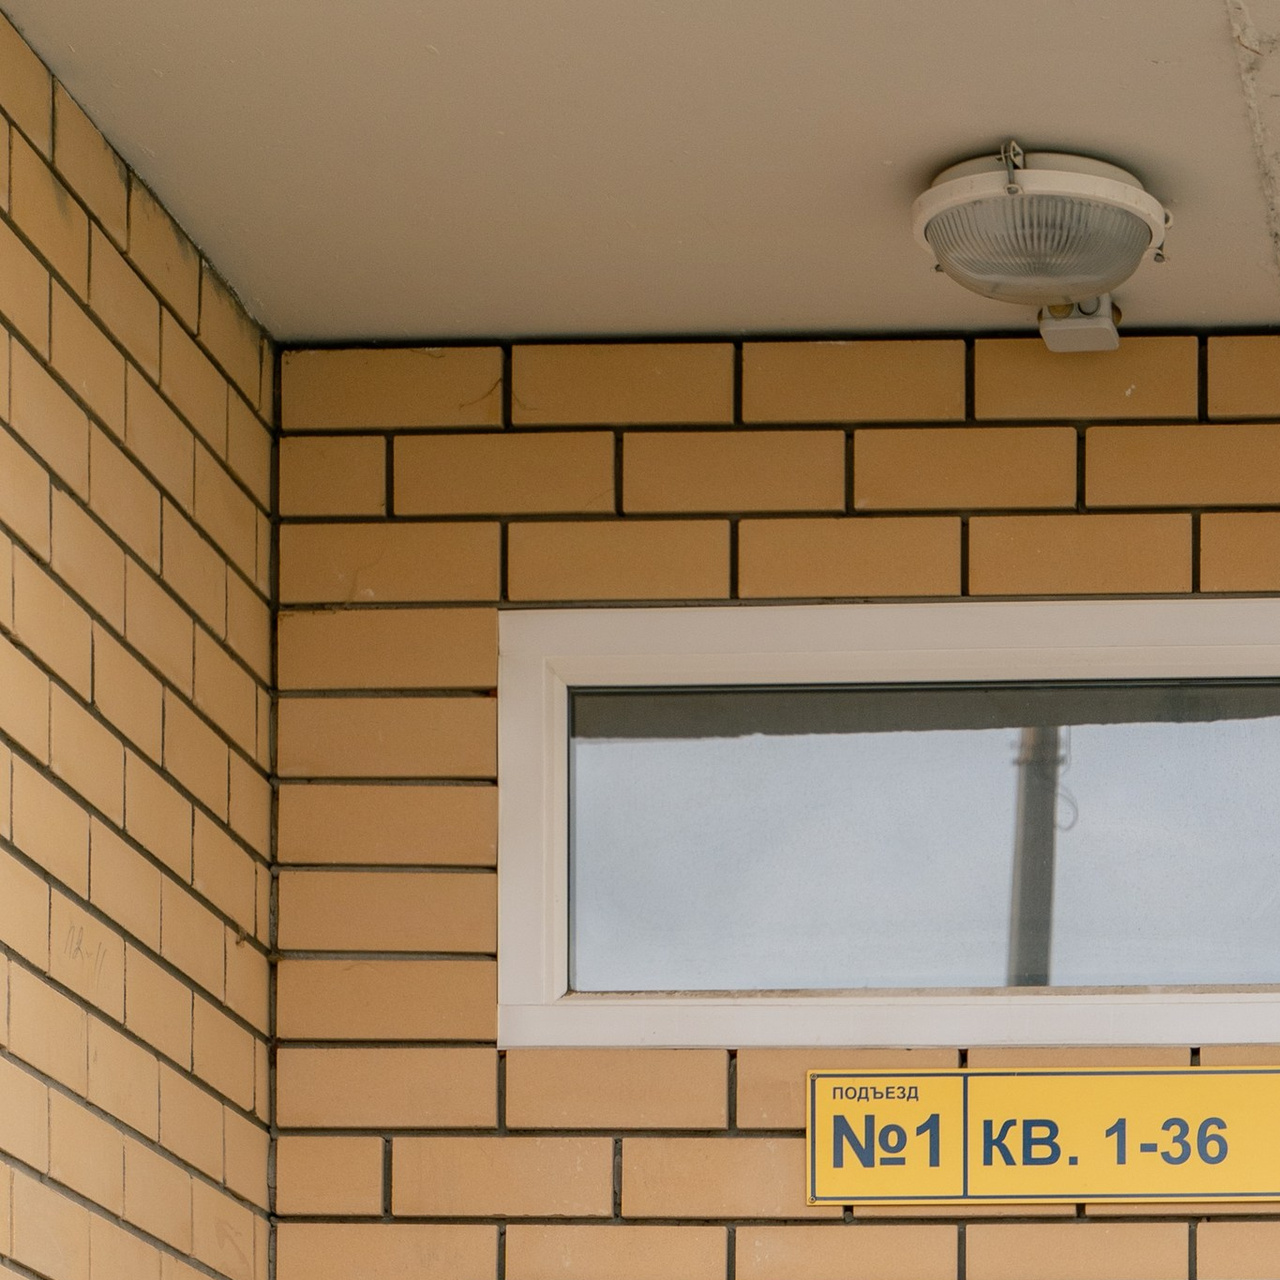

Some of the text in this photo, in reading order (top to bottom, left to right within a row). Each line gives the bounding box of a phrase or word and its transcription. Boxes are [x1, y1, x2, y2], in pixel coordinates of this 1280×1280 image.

[832, 1086, 920, 1102] ПОДЪЕЗД
[832, 1113, 1230, 1169] №1 КВ. 1-36
